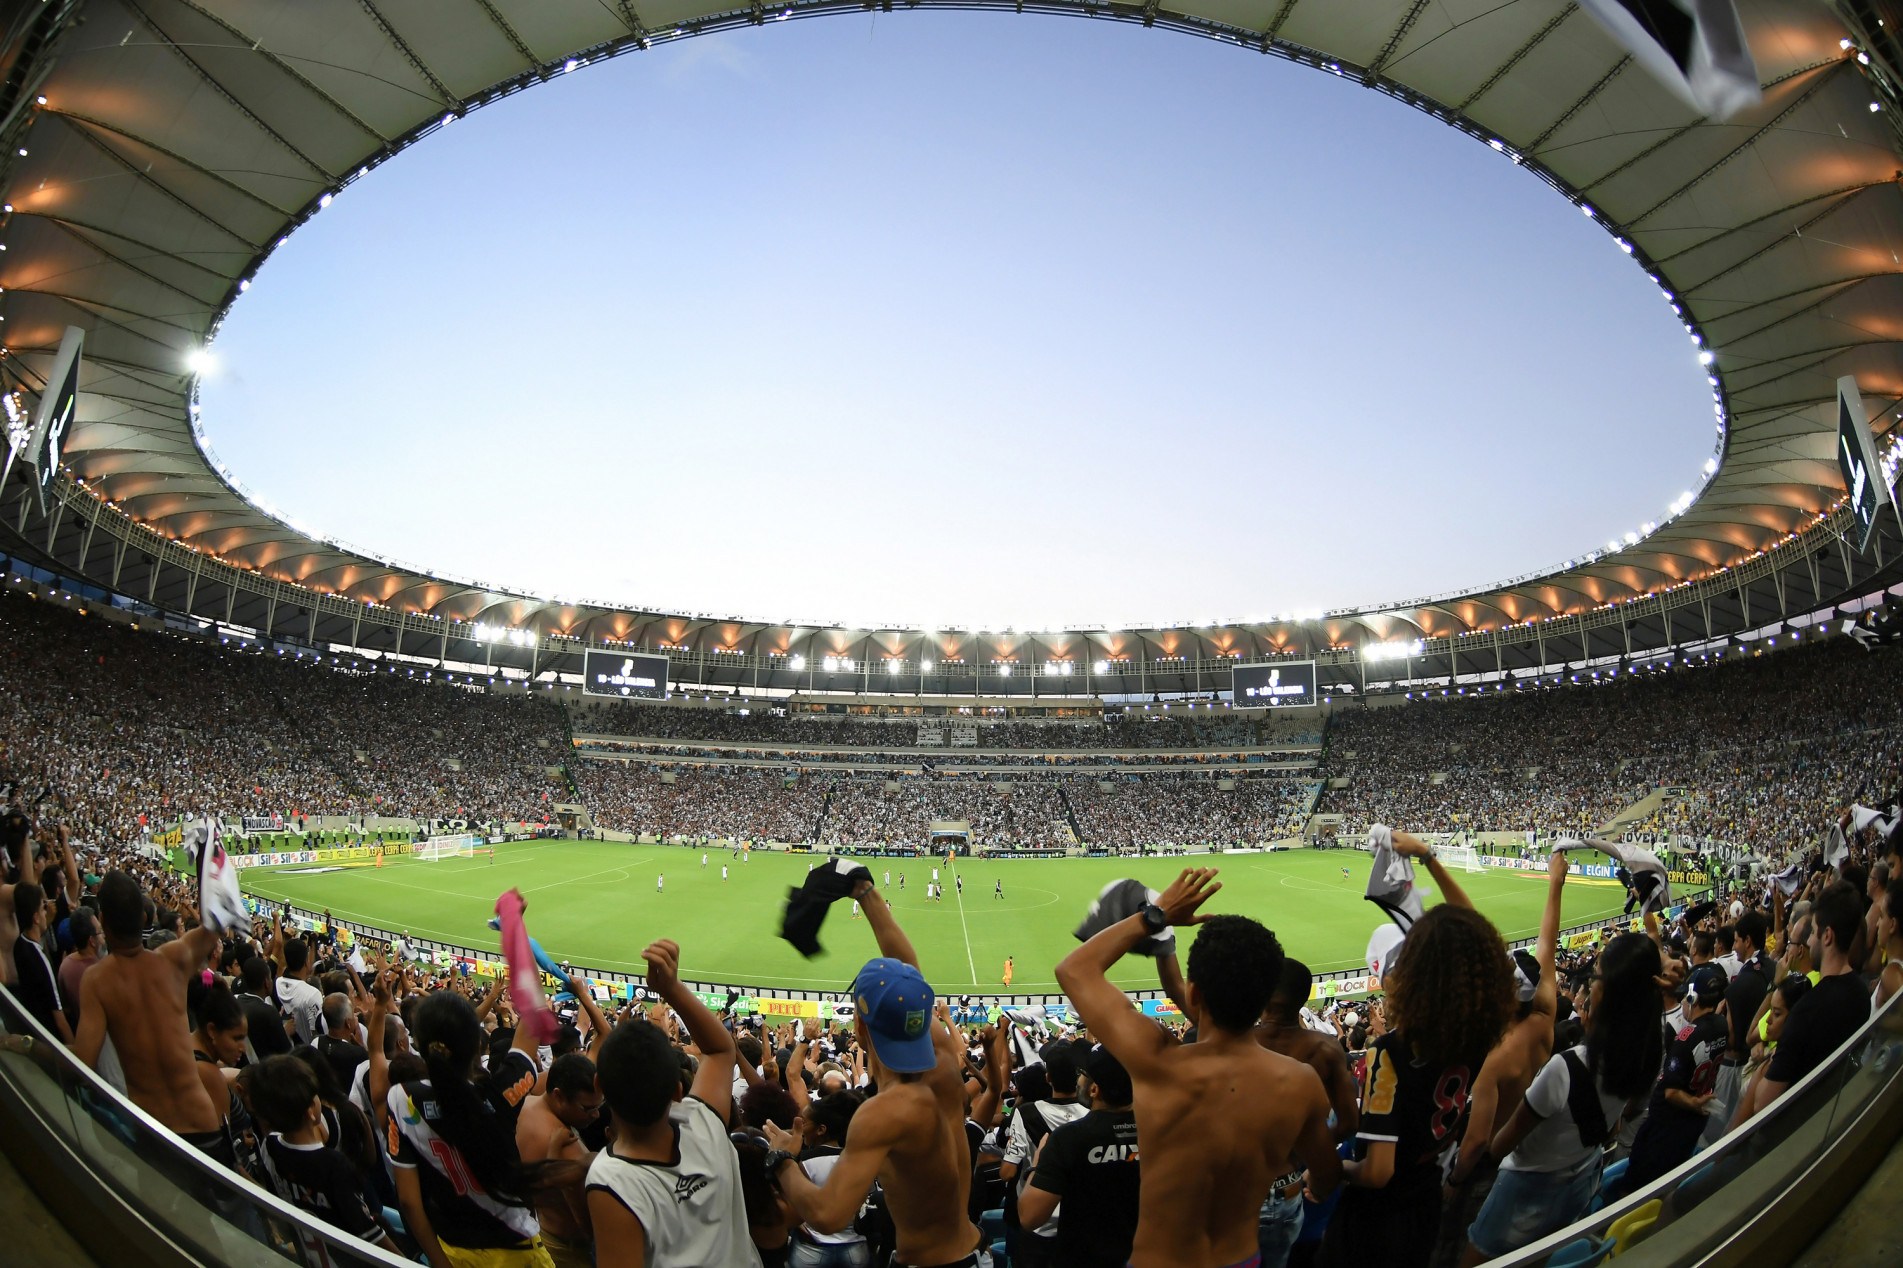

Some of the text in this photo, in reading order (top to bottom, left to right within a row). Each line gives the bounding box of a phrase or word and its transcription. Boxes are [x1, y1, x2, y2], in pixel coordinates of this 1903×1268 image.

[260, 855, 271, 865] Sil
[281, 853, 290, 864] Sil
[300, 852, 310, 862] Sil
[1586, 865, 1611, 877] ELGIN
[1668, 871, 1685, 884] ERPA
[710, 996, 749, 1010] Sicedi
[1088, 1144, 1140, 1164] CAIX
